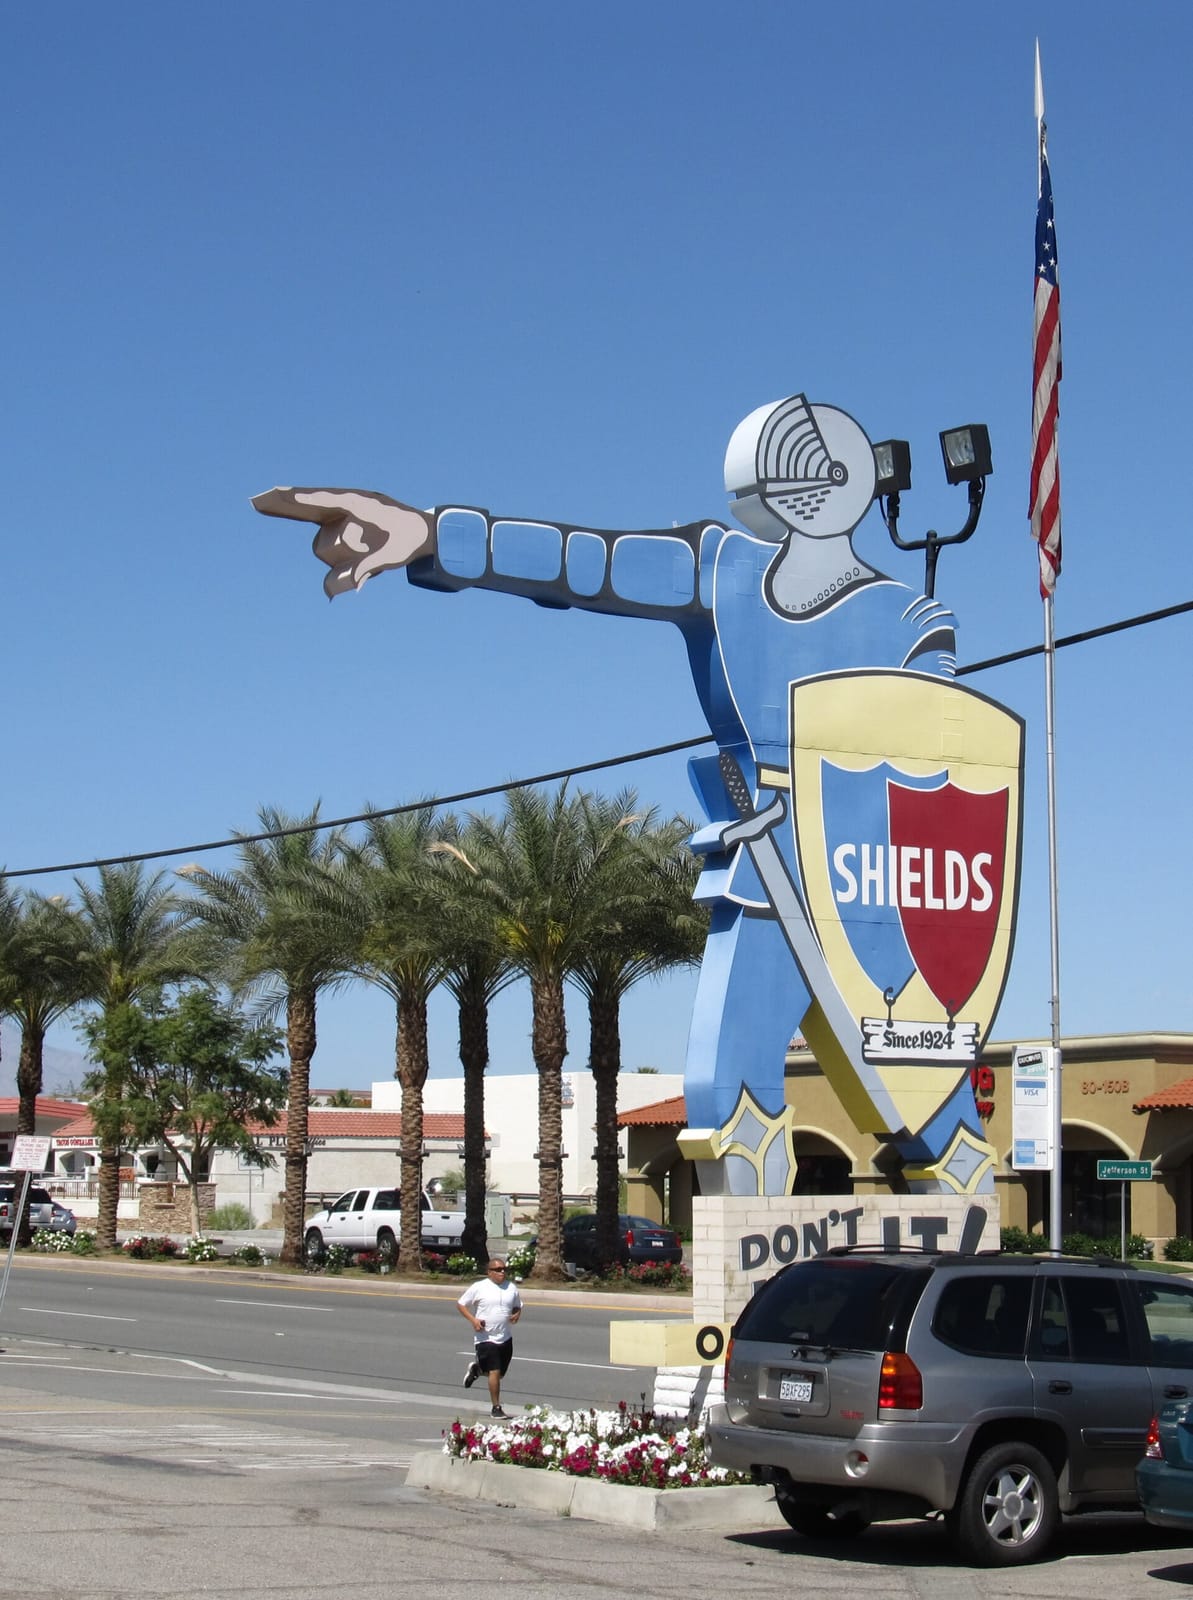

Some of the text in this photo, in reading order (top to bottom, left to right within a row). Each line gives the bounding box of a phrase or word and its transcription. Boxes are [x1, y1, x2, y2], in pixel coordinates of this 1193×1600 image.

[833, 843, 994, 912] SHIELDS
[1023, 1088, 1039, 1097] VISA
[1102, 1165, 1149, 1175] Jefferson St
[739, 1206, 864, 1271] DON'T
[781, 1383, 812, 1398] 5BXF295
